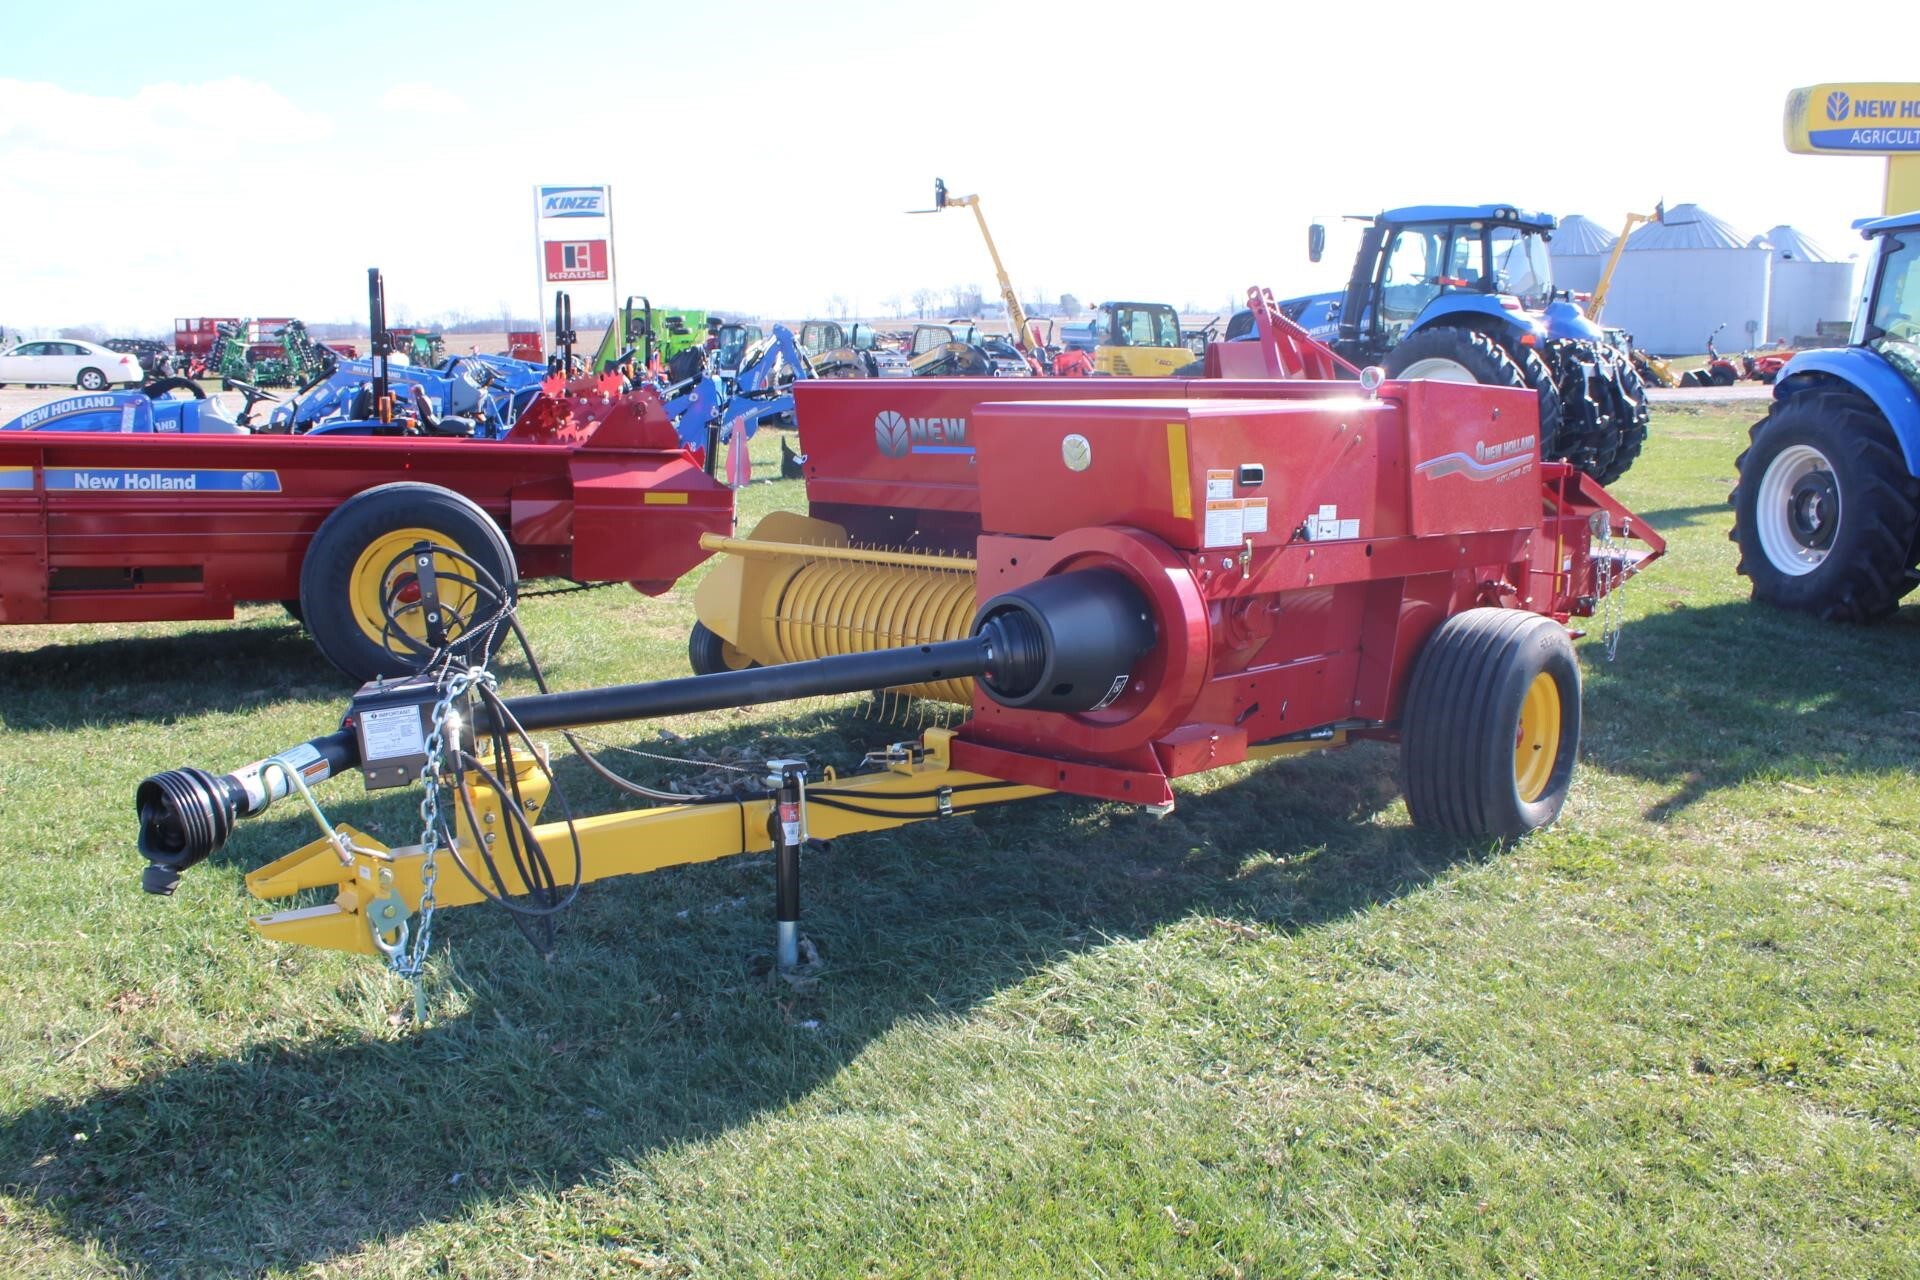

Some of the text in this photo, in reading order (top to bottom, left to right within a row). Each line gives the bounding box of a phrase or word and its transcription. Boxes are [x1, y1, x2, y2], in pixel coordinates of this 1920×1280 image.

[1854, 99, 1897, 118] NEW
[545, 196, 601, 210] KINZE
[549, 271, 606, 280] KRAUSE
[21, 396, 114, 429] NEW HOLLAND
[909, 417, 966, 443] NEW
[1503, 434, 1536, 456] HOLLAND
[74, 472, 196, 490] New Holland
